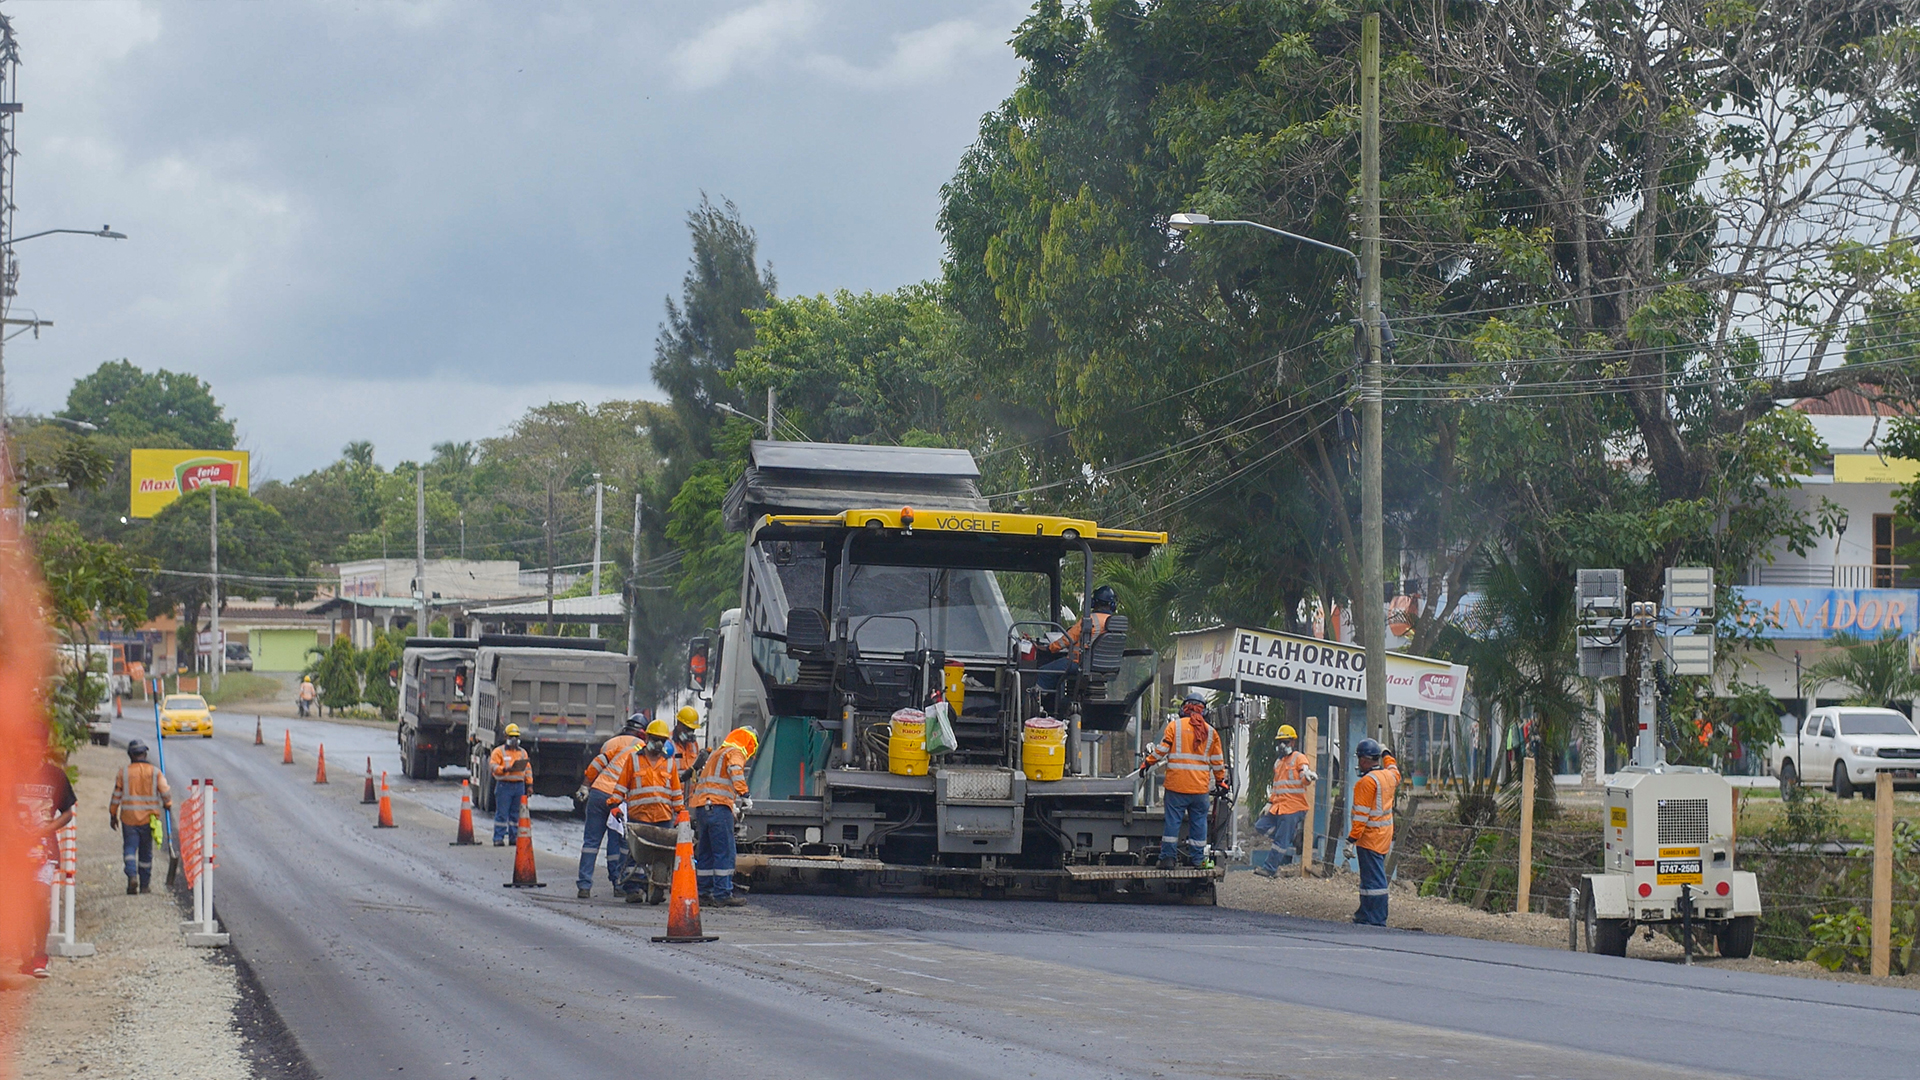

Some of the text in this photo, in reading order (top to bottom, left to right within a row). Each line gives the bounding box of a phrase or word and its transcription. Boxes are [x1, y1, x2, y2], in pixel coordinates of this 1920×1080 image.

[140, 478, 176, 492] Maxi
[936, 515, 1000, 532] VÖGELE
[1239, 634, 1366, 672] EL AHORRO
[1237, 659, 1290, 681] LLEGÓ
[1294, 668, 1306, 684] A
[1312, 671, 1363, 692] TORTÍ
